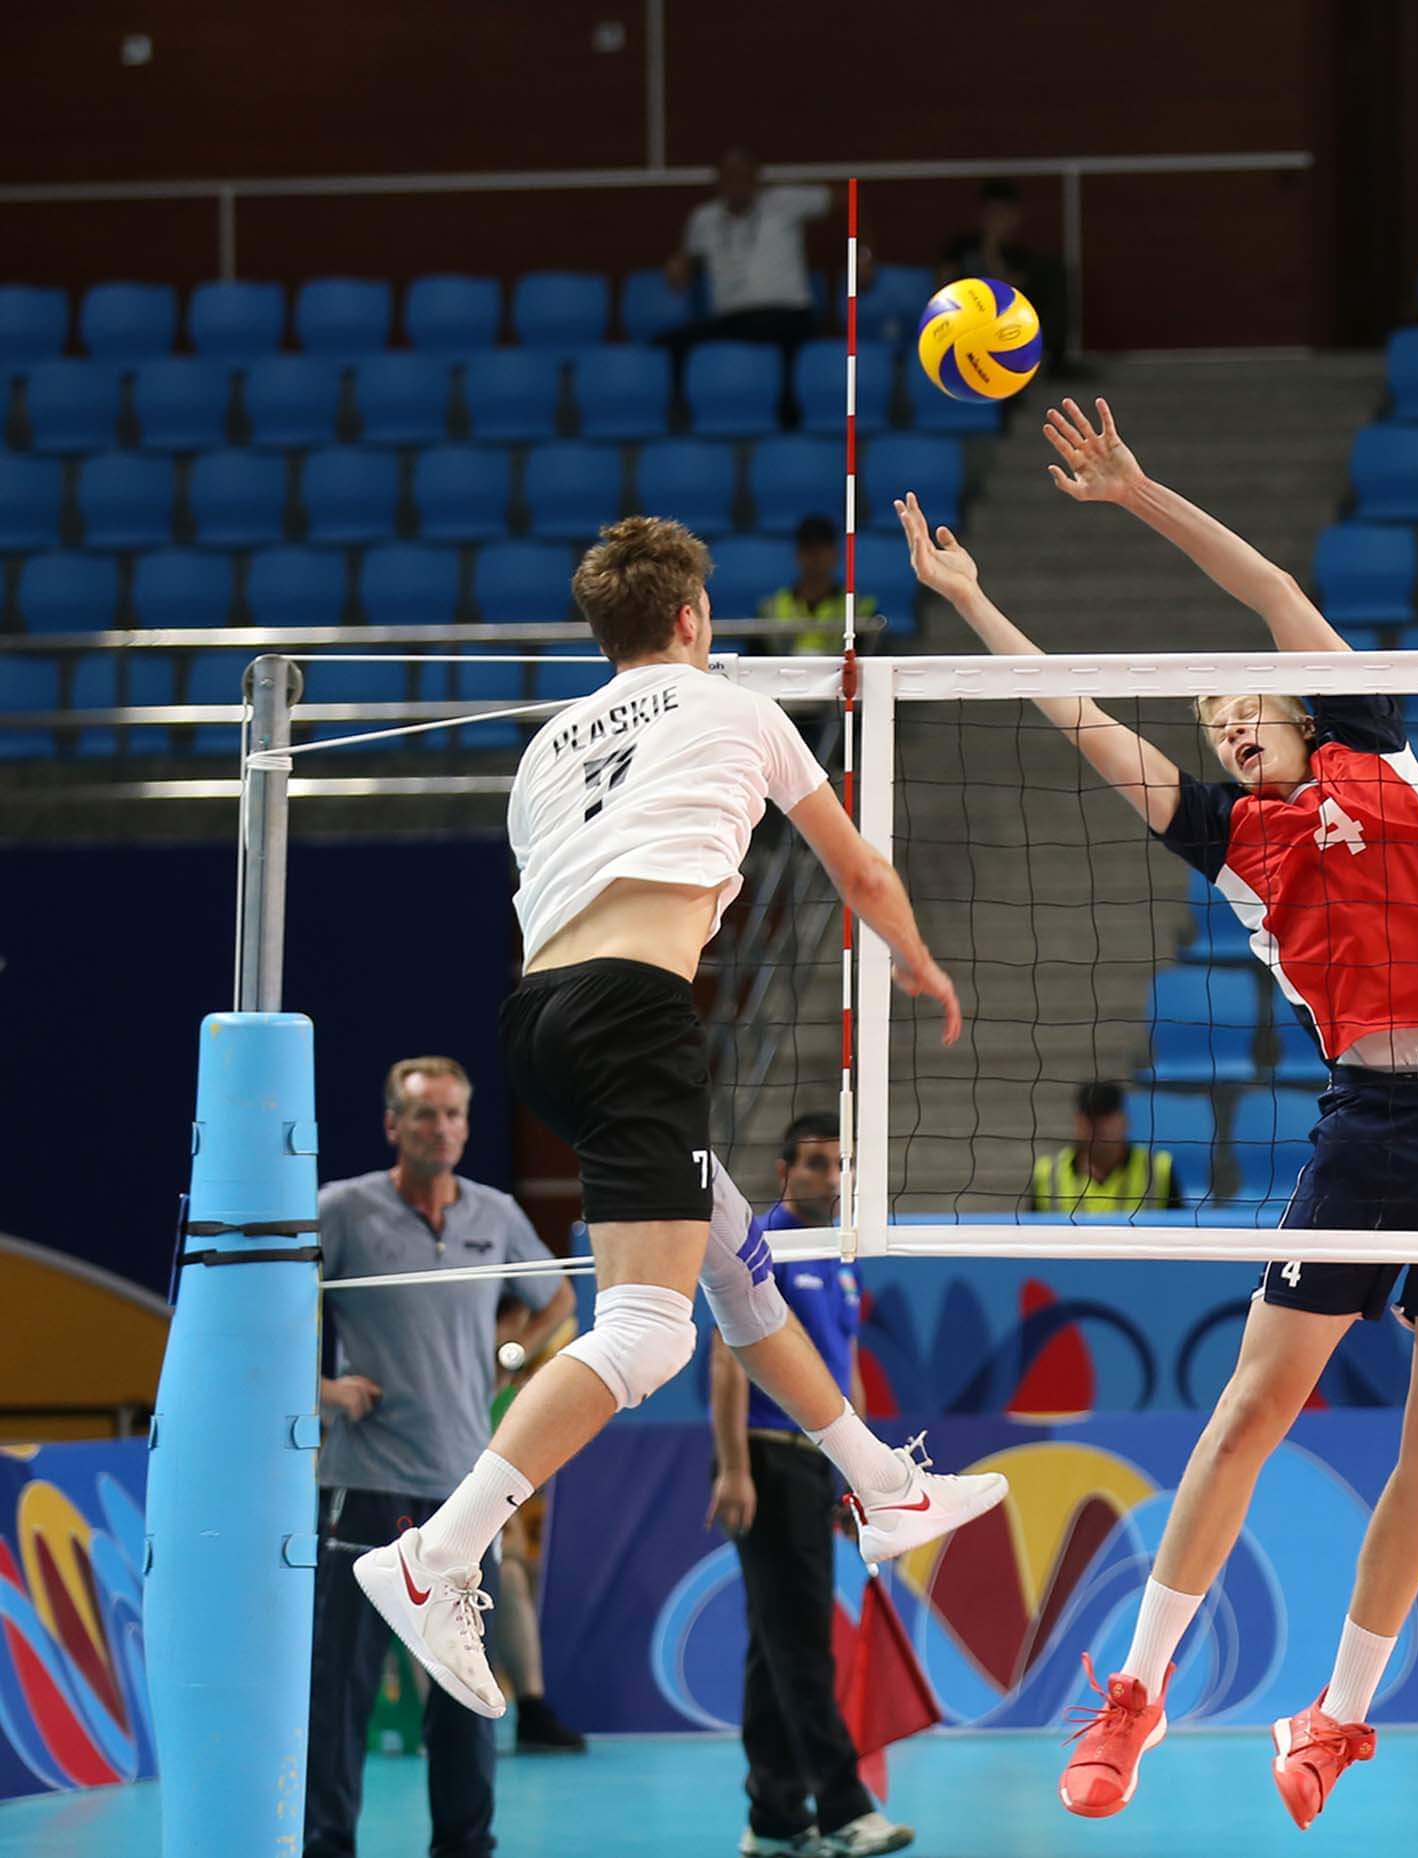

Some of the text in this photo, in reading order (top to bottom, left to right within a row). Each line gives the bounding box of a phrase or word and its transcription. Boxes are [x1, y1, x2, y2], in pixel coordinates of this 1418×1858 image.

[583, 743, 638, 823] 7
[1313, 796, 1367, 856] 4
[692, 1150, 708, 1189] 7
[1281, 1261, 1301, 1287] 4
